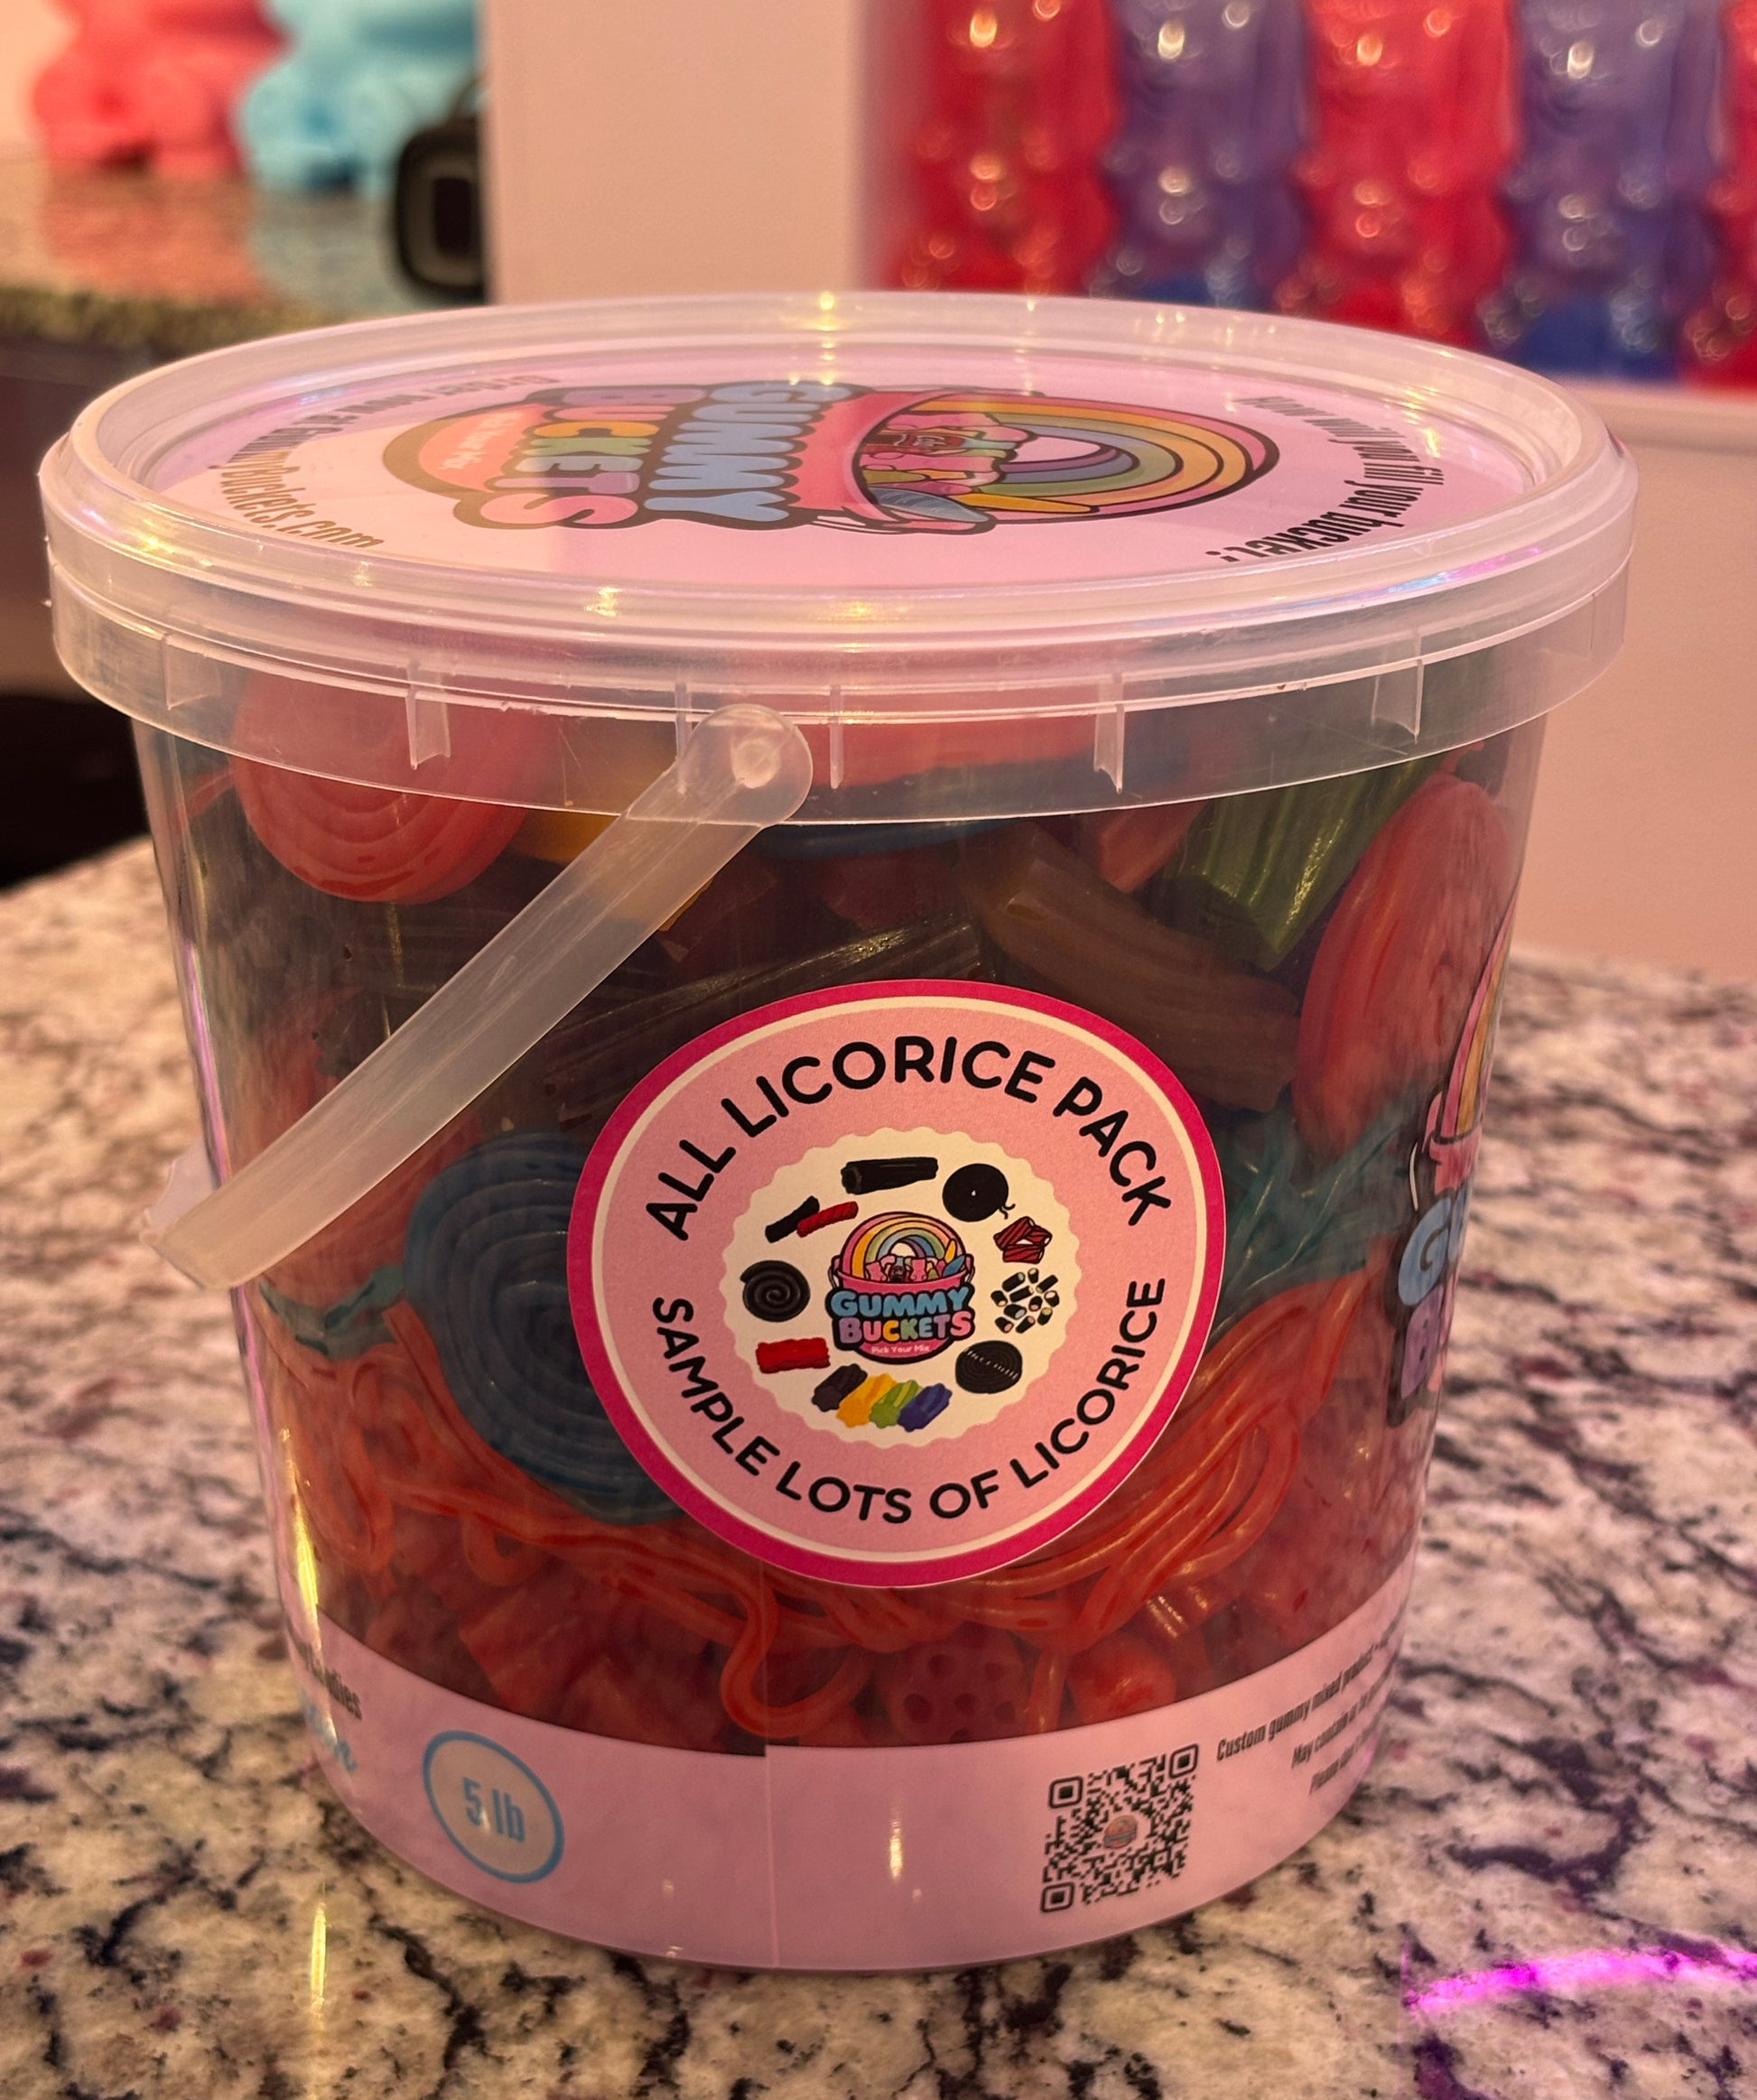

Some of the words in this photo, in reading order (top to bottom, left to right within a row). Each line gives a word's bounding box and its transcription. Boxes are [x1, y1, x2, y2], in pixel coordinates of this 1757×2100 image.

[425, 375, 562, 395] Order
[293, 413, 360, 426] at
[337, 394, 432, 415] now
[1233, 395, 1336, 417] How
[1303, 417, 1407, 439] will
[480, 388, 709, 525] BUCKETS
[644, 384, 852, 522] GUMMY
[1327, 440, 1421, 462] you
[1362, 462, 1445, 486] fill
[1338, 479, 1425, 518] your
[646, 1140, 736, 1240] ALL
[721, 1036, 1055, 1137] LICORICE
[1053, 1078, 1171, 1226] PACK
[831, 1287, 969, 1317] GUMMY
[839, 1311, 971, 1343] BUCKETS
[653, 1296, 779, 1476] SAMPLE
[776, 1461, 912, 1523] LOTS
[929, 1470, 999, 1519] OF
[1010, 1278, 1165, 1489] LICORICE
[1217, 1724, 1267, 1761] Custom
[1269, 1698, 1311, 1740] gummy
[1291, 1742, 1314, 1769] May
[463, 1776, 483, 1827] 5
[491, 1789, 526, 1843] lb
